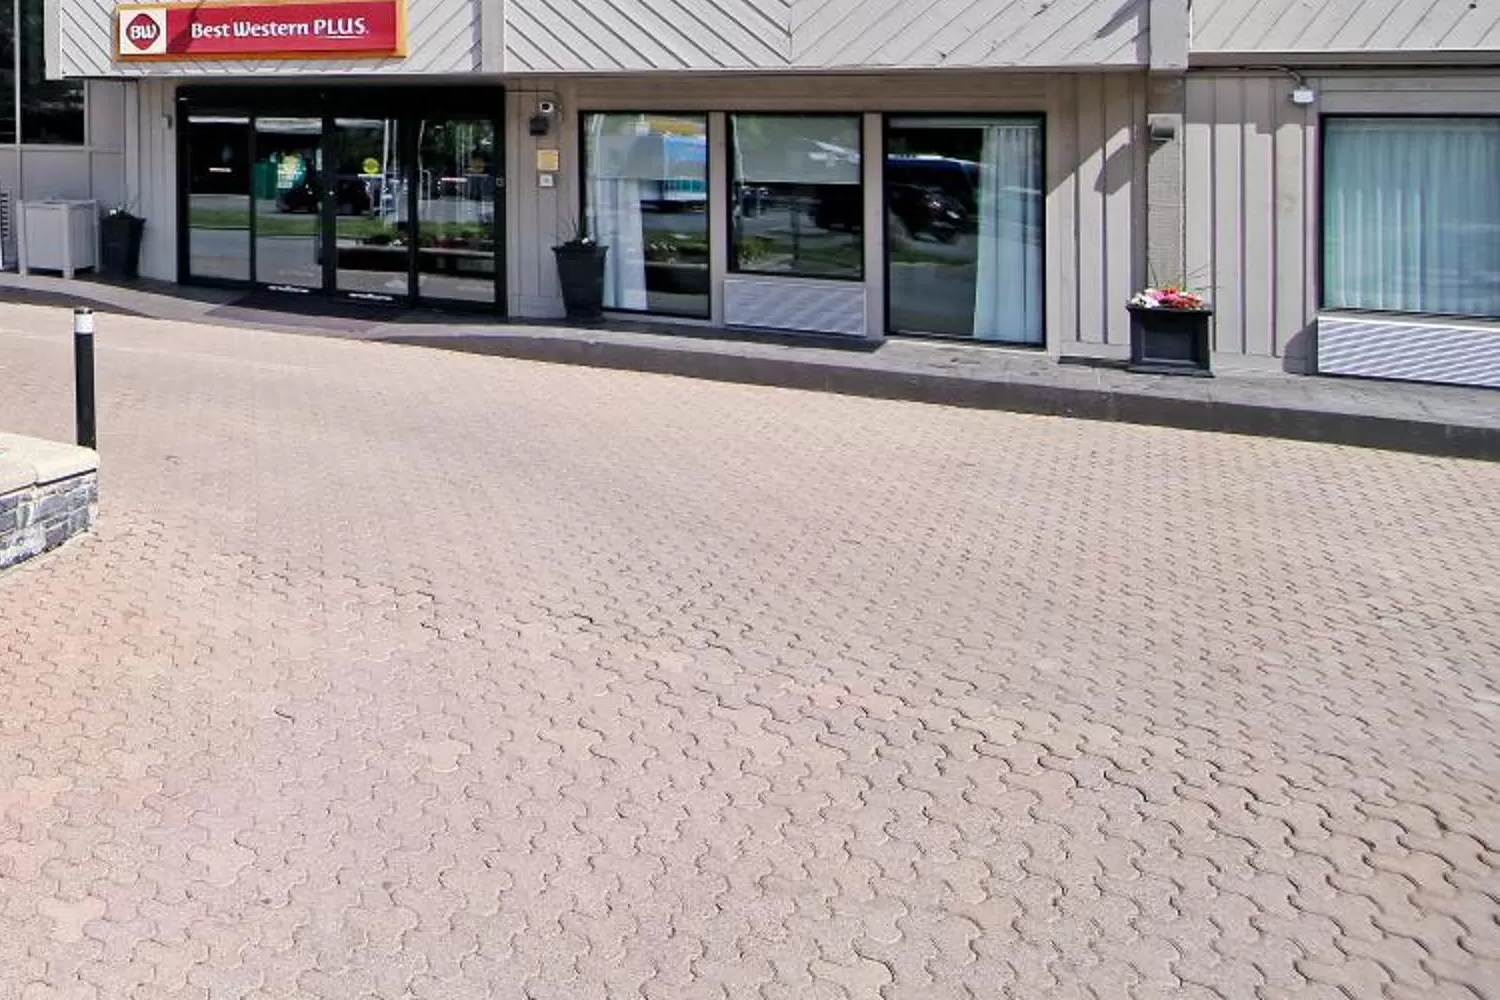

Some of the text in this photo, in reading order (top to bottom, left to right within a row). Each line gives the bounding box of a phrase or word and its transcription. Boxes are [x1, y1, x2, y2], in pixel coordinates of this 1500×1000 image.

[131, 23, 156, 40] BW
[192, 17, 366, 38] Best Western PLUS
